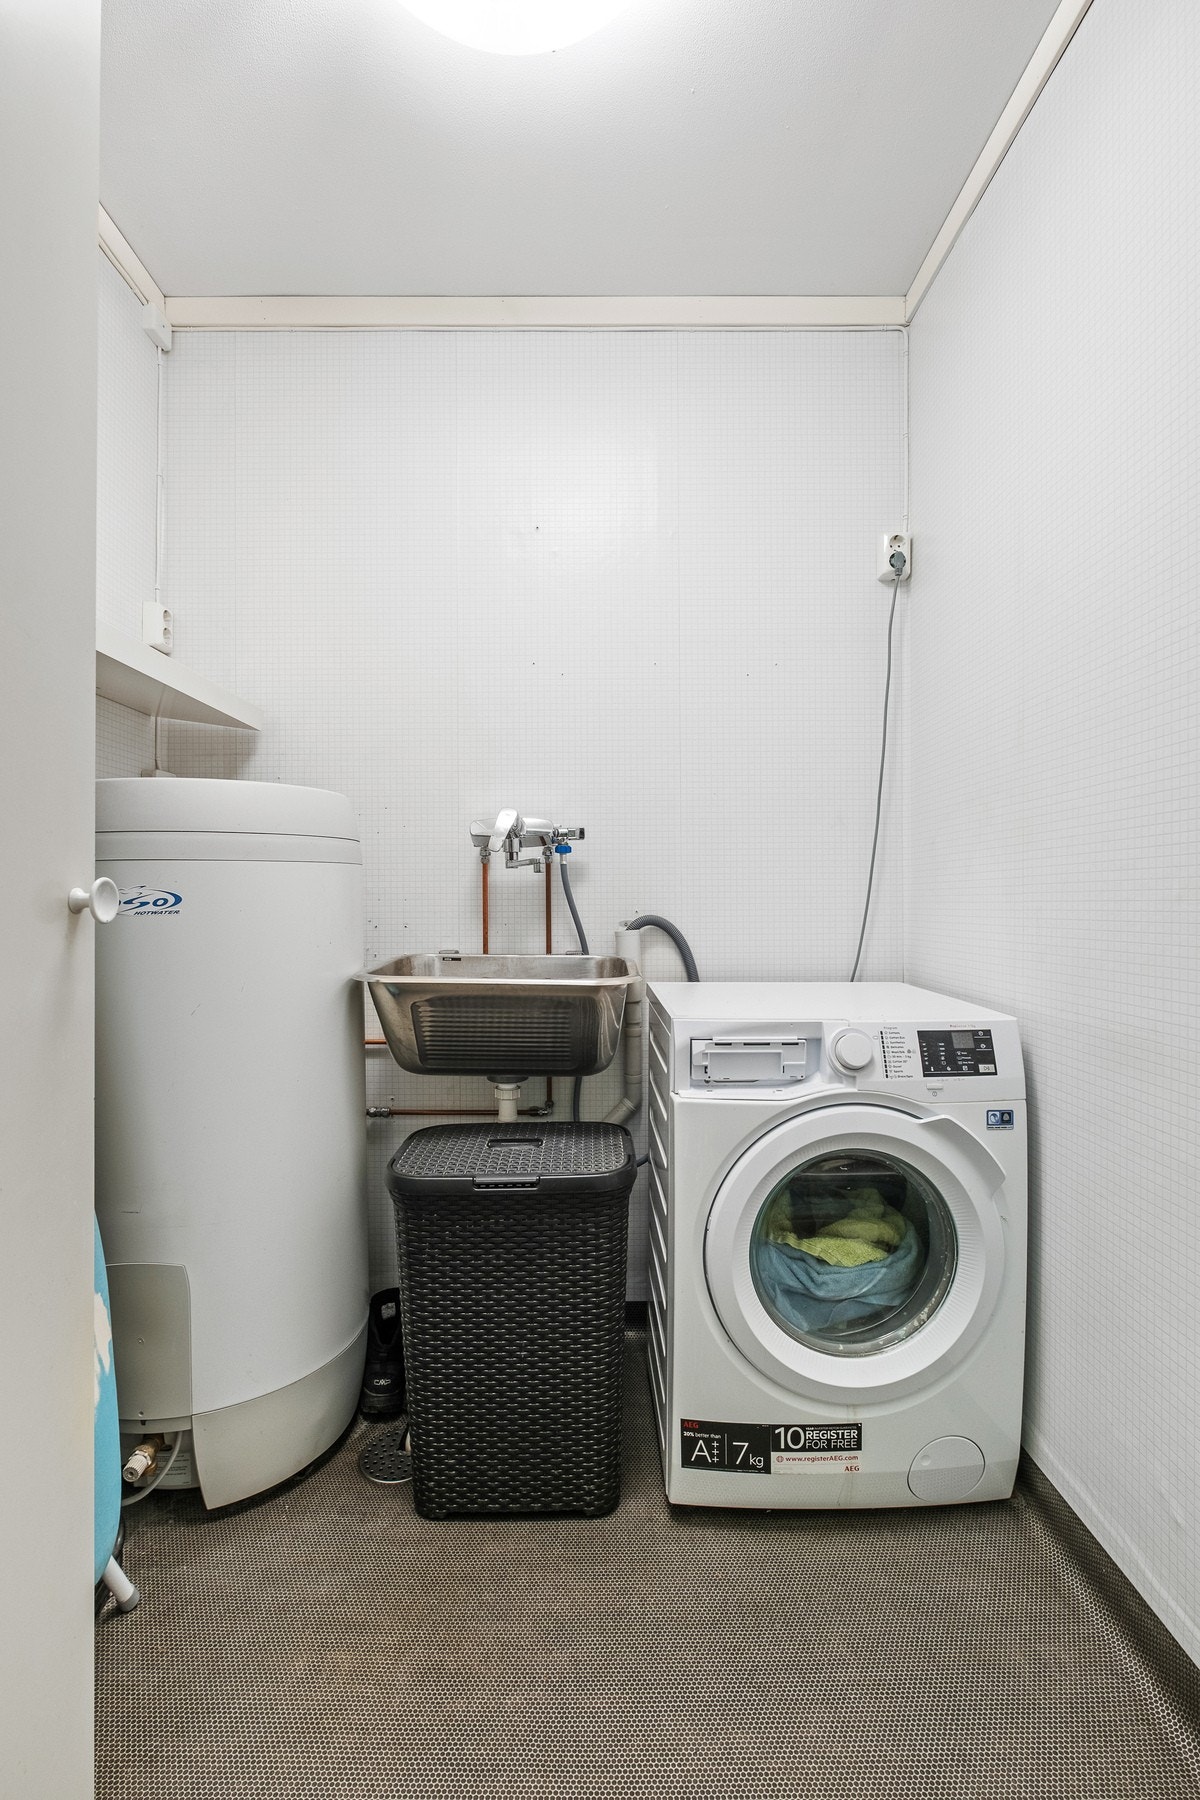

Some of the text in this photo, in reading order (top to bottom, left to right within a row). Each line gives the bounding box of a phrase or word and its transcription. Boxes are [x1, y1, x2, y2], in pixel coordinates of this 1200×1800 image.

[683, 1421, 699, 1429] AEG
[775, 1426, 805, 1450] 10
[805, 1429, 858, 1440] REGISTER
[805, 1439, 858, 1449] FOR FREE
[732, 1441, 764, 1469] 7 kg
[785, 1454, 859, 1463] www.registerAEG.com
